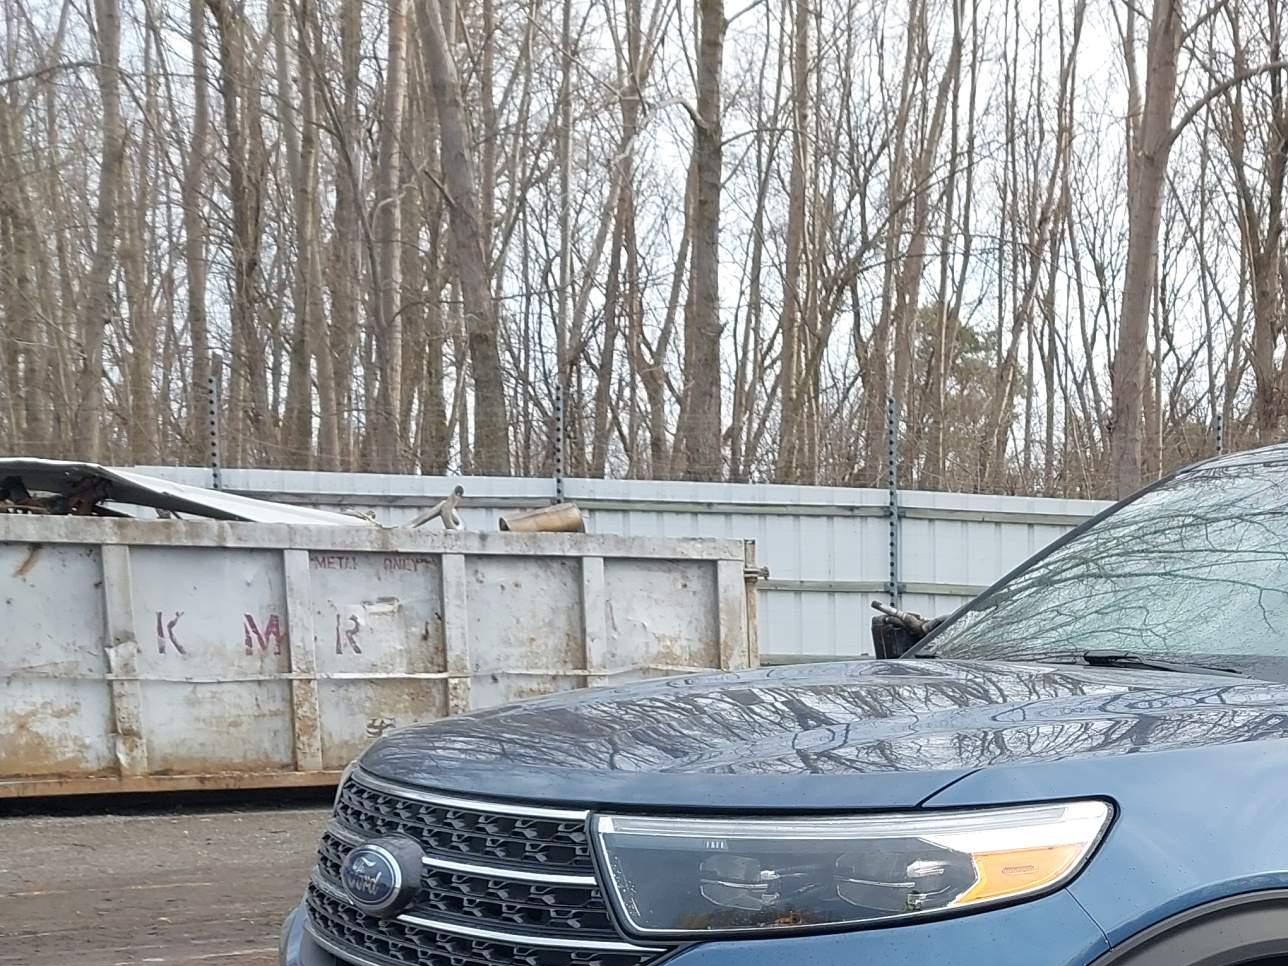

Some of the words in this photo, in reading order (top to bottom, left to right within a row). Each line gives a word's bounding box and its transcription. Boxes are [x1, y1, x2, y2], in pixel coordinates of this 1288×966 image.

[155, 610, 187, 656] K
[243, 612, 285, 657] M
[335, 613, 363, 656] R
